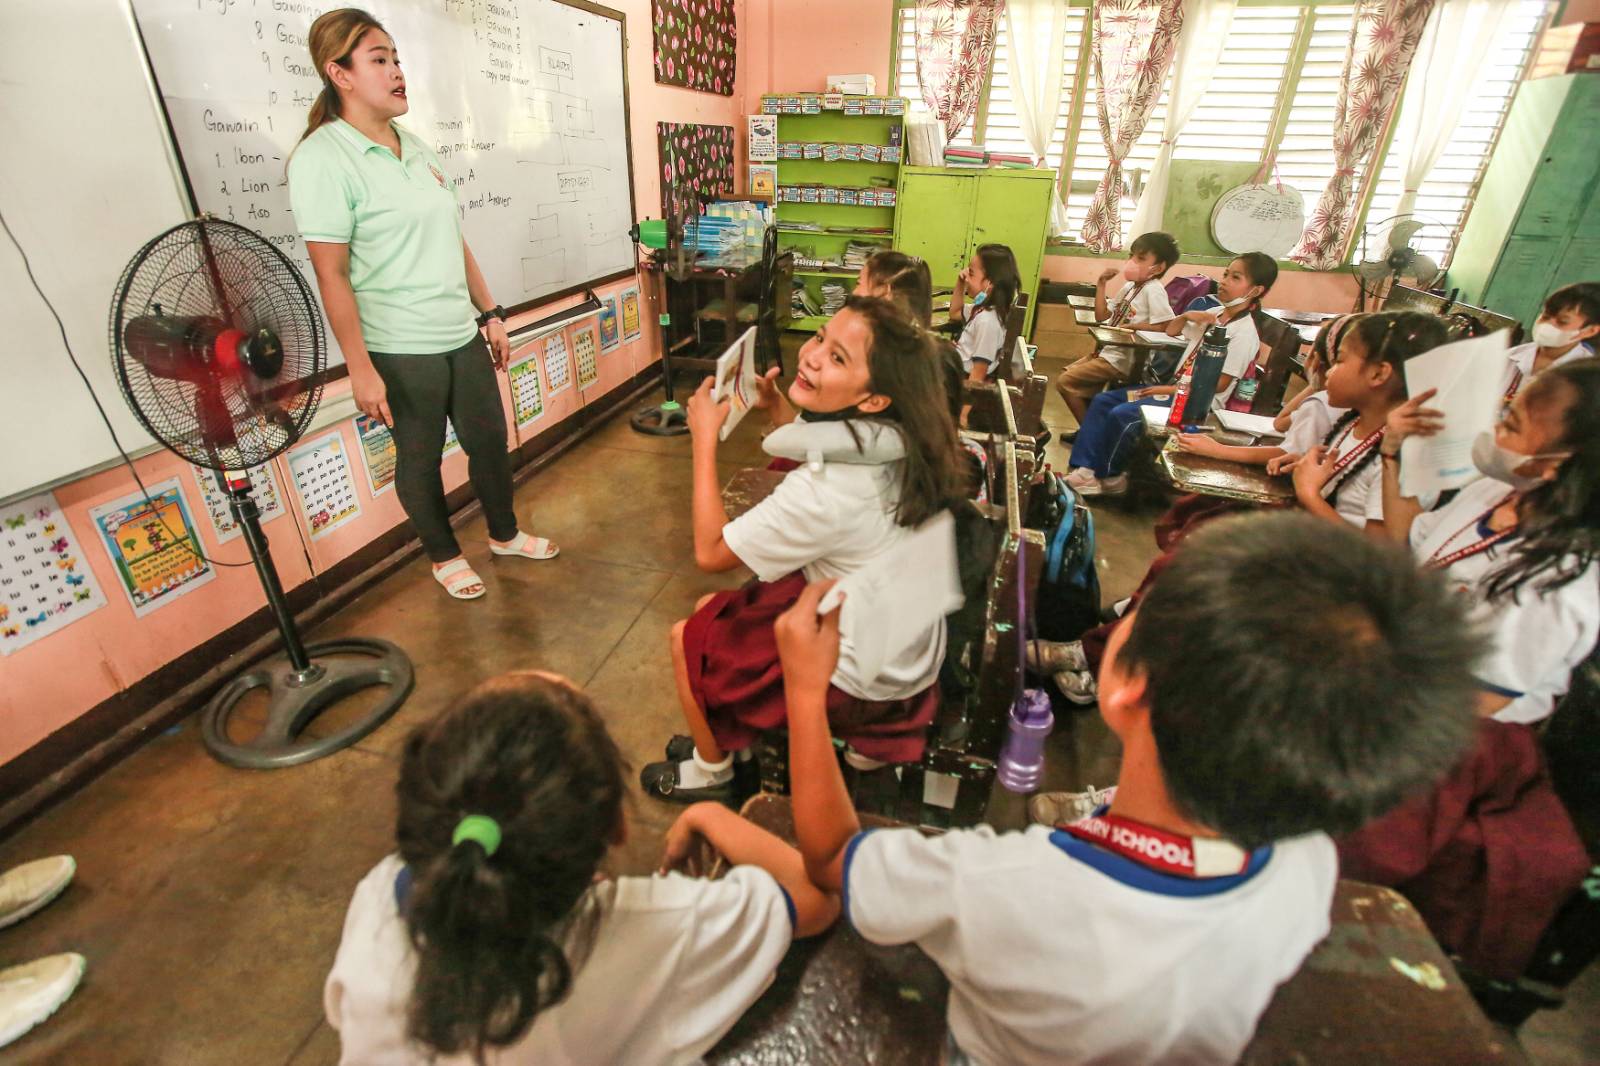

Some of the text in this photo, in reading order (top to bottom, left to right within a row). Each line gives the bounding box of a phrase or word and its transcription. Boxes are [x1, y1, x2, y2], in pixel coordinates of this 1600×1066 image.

[255, 20, 263, 40] 8
[262, 51, 272, 73] 9
[203, 108, 259, 132] Gawain
[234, 147, 265, 165] Ibon
[241, 177, 271, 194] Lion
[1338, 432, 1380, 467] ELEMENTARY
[1110, 824, 1195, 868] SCHOOL
